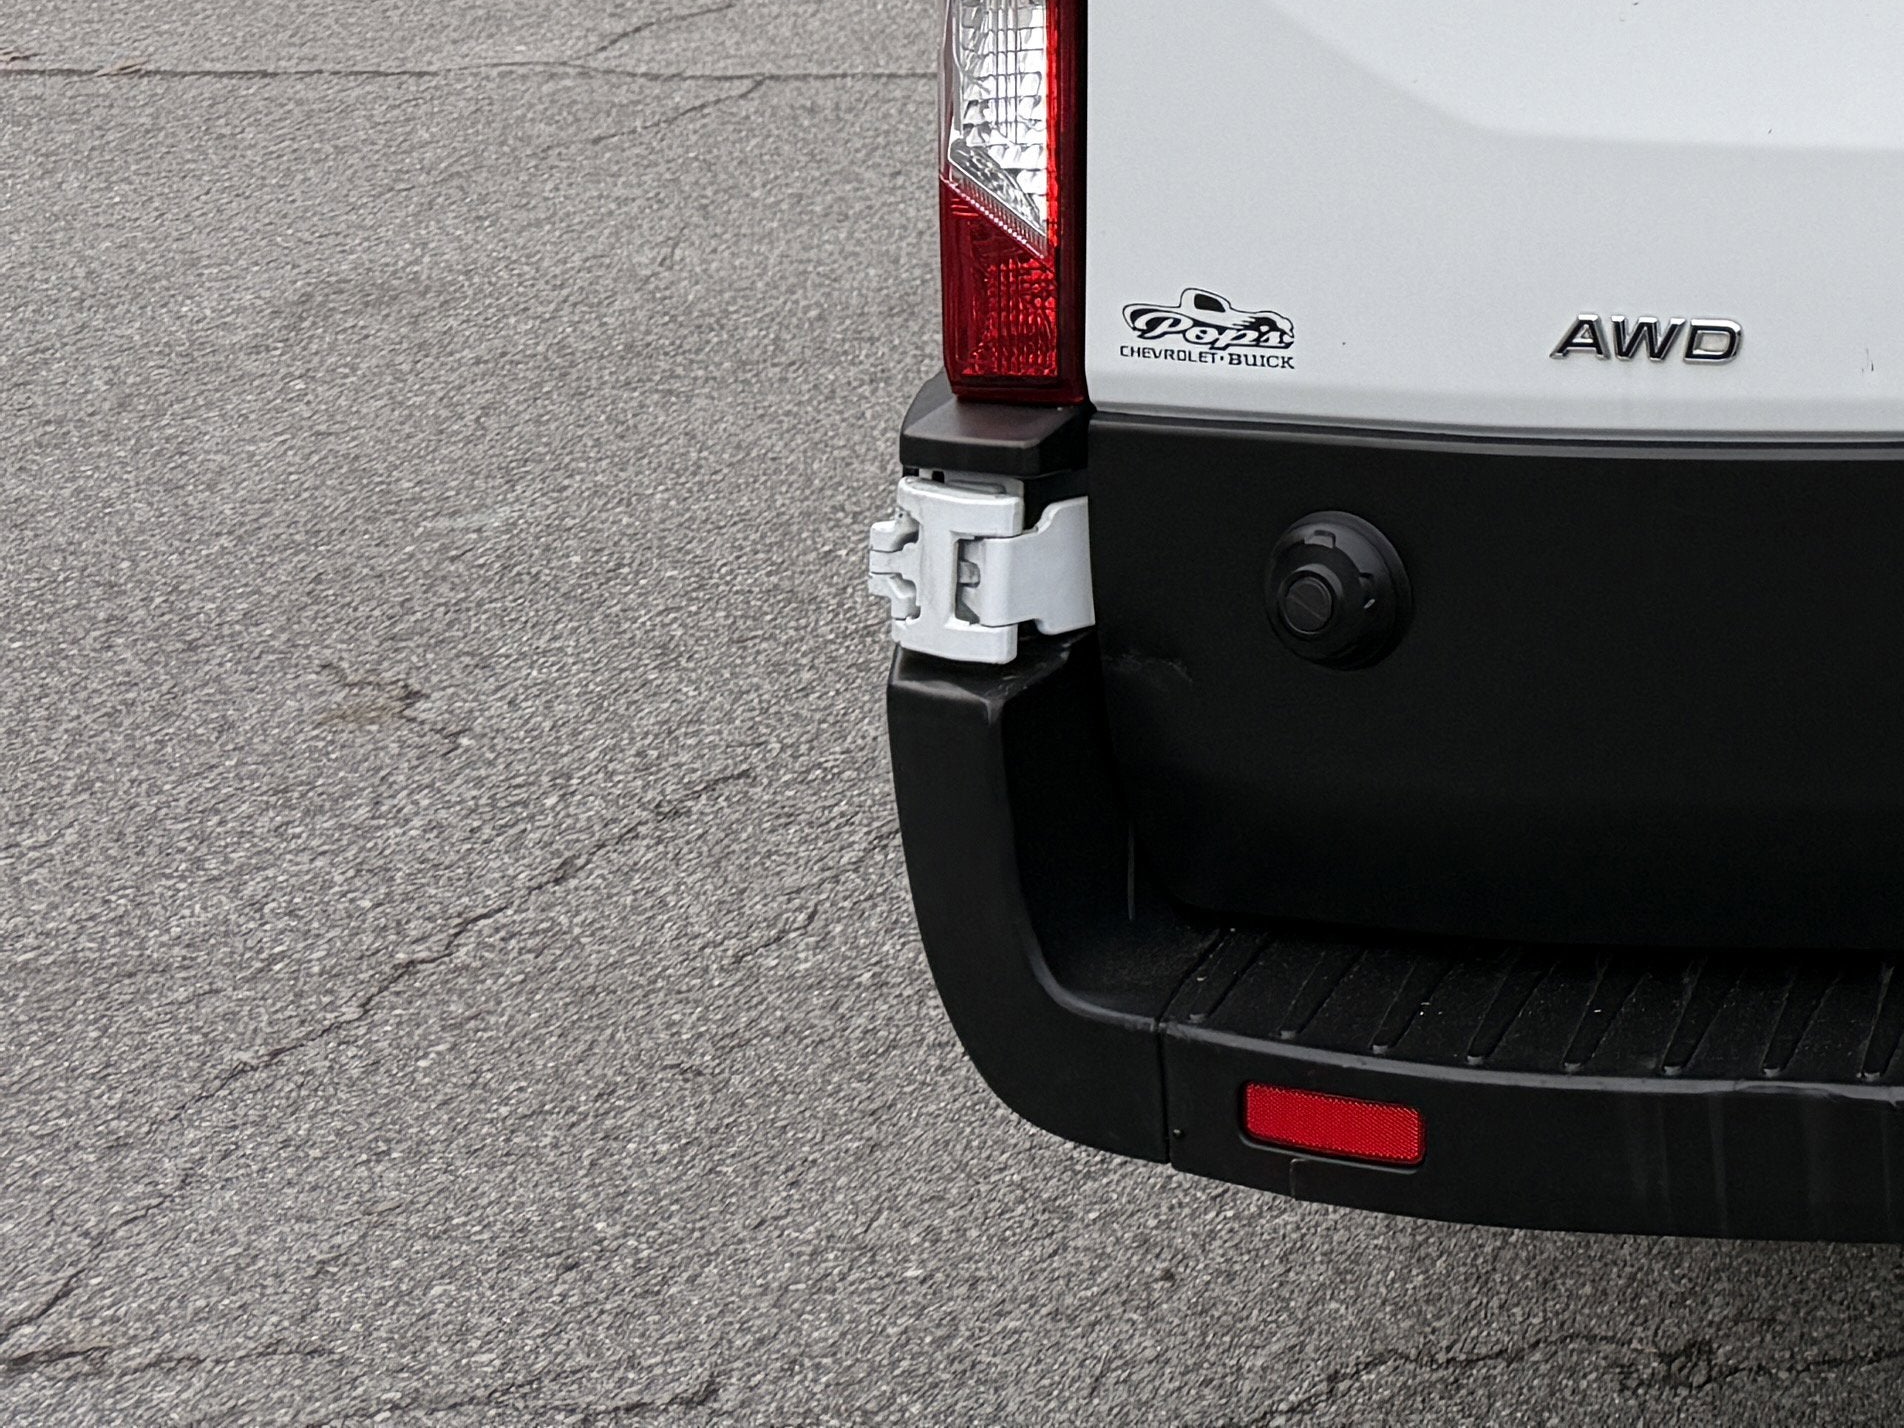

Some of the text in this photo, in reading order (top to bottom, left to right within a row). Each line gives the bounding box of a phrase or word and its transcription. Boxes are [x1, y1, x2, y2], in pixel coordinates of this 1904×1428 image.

[1119, 345, 1295, 369] CHEVROLET BUICK
[1549, 312, 1743, 364] AWD
